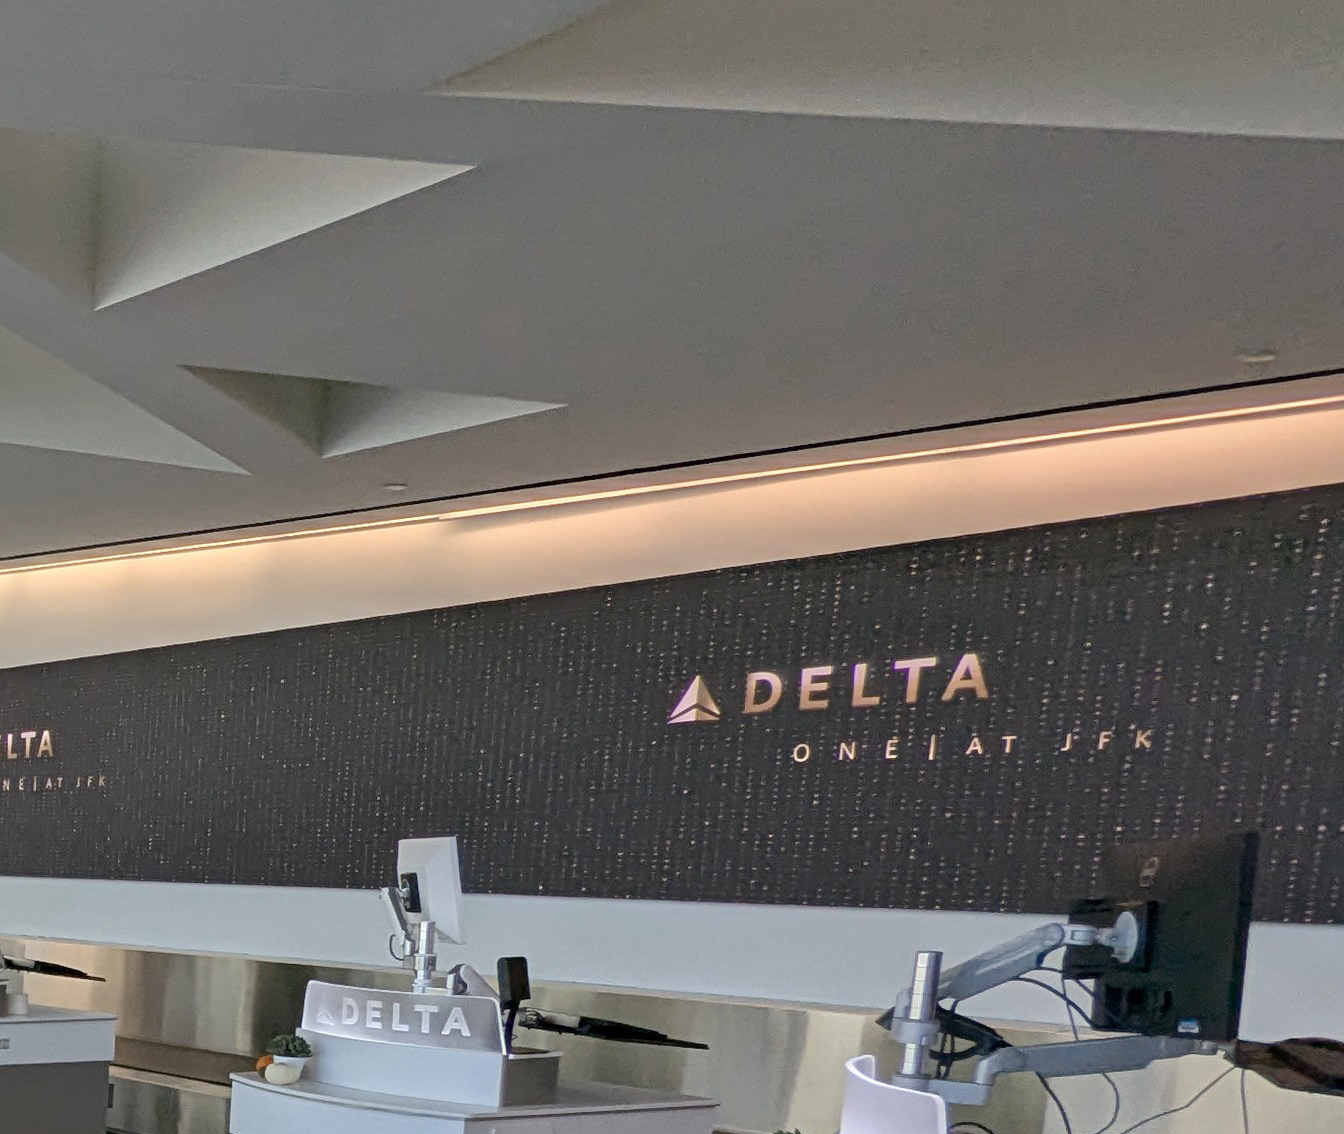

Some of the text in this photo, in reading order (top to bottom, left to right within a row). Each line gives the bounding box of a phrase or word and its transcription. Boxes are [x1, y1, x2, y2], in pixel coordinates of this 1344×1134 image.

[741, 653, 989, 716] DELTA
[1060, 729, 1154, 752] JFK
[75, 775, 107, 789] JFK
[341, 996, 471, 1037] DELTA
